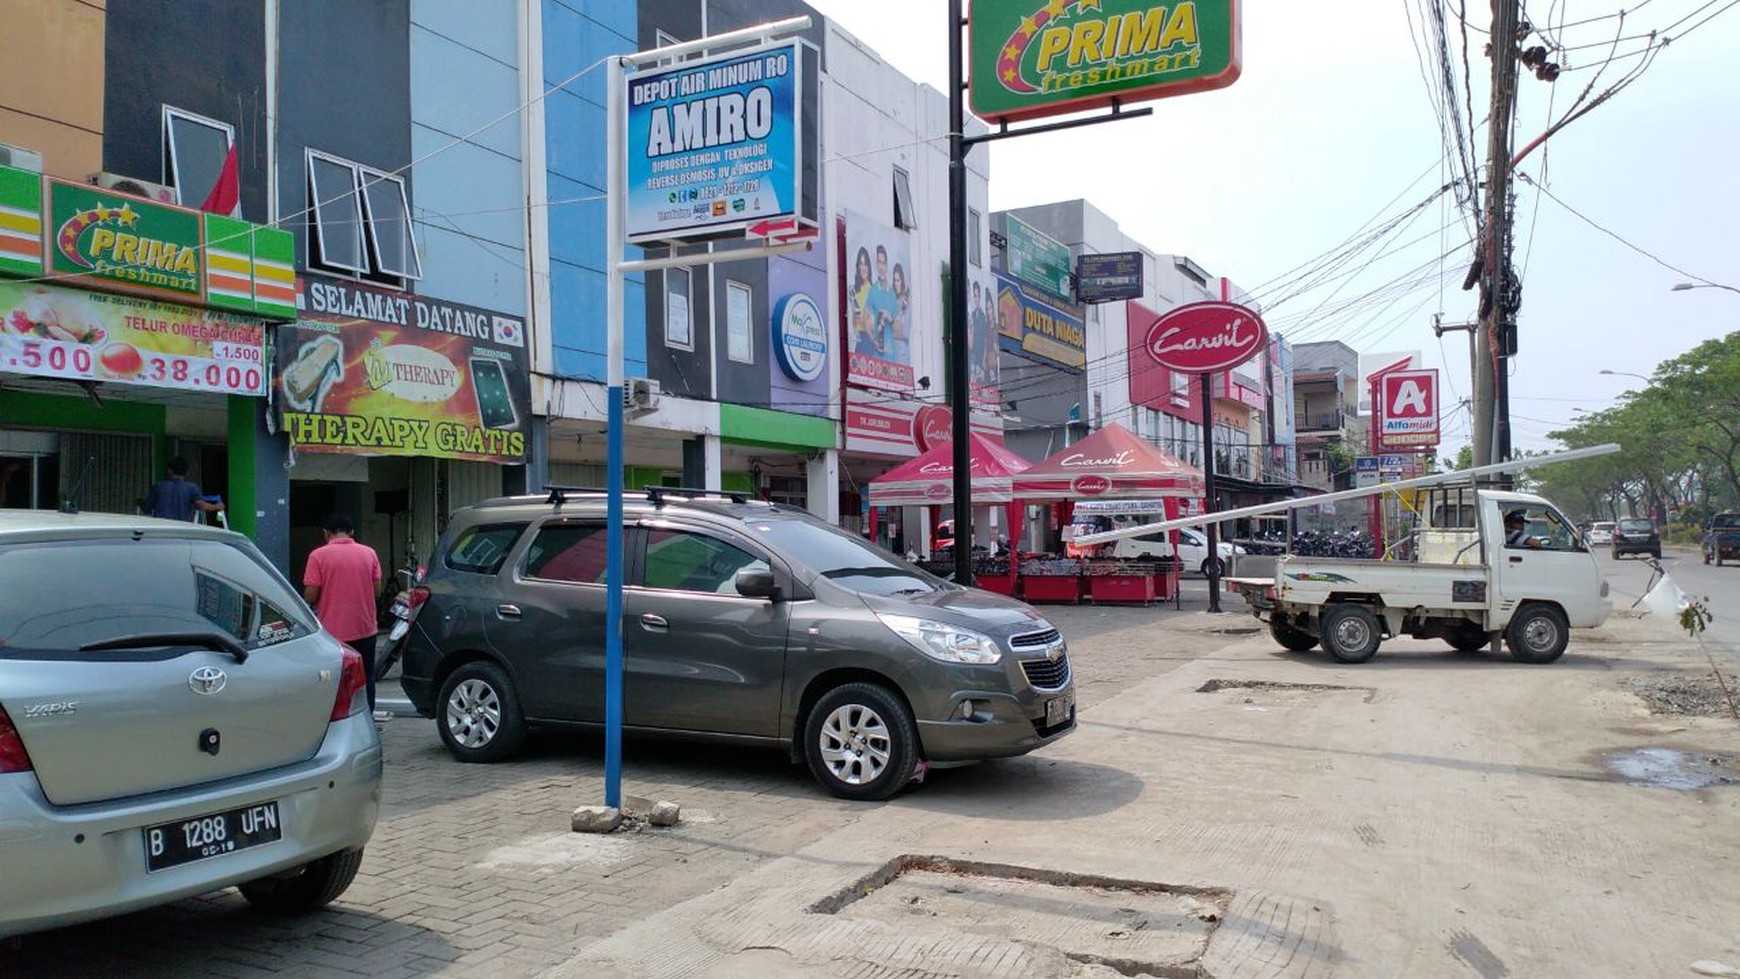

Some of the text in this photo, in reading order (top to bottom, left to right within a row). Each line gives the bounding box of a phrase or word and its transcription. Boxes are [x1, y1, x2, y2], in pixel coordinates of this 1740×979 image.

[1037, 1, 1199, 73] PRIMA
[633, 54, 788, 106] DEPOT AIR MINUM RO
[1041, 48, 1201, 93] freshmart
[646, 86, 773, 158] AMIRO
[651, 143, 767, 174] DIPROSES DENGAN TEKNOLOGI
[718, 165, 730, 178] UV
[737, 159, 773, 175] OKSIGEN
[89, 227, 197, 274] PRIMA
[94, 259, 197, 291] freshmart
[124, 315, 168, 334] TELUR
[171, 322, 218, 341] OMEGA
[311, 282, 410, 326] SELAMAT
[415, 302, 490, 340] DATANG
[1024, 305, 1085, 348] DUTA NIAGA
[1153, 318, 1255, 355] Carvil
[150, 357, 261, 391] 38.000
[392, 362, 456, 388] THERAPY
[283, 412, 525, 457] THERAPY GRATIS
[1386, 420, 1435, 432] Alfamidi
[1059, 450, 1136, 467] Carvil
[150, 804, 276, 857] B 1288 UFN
